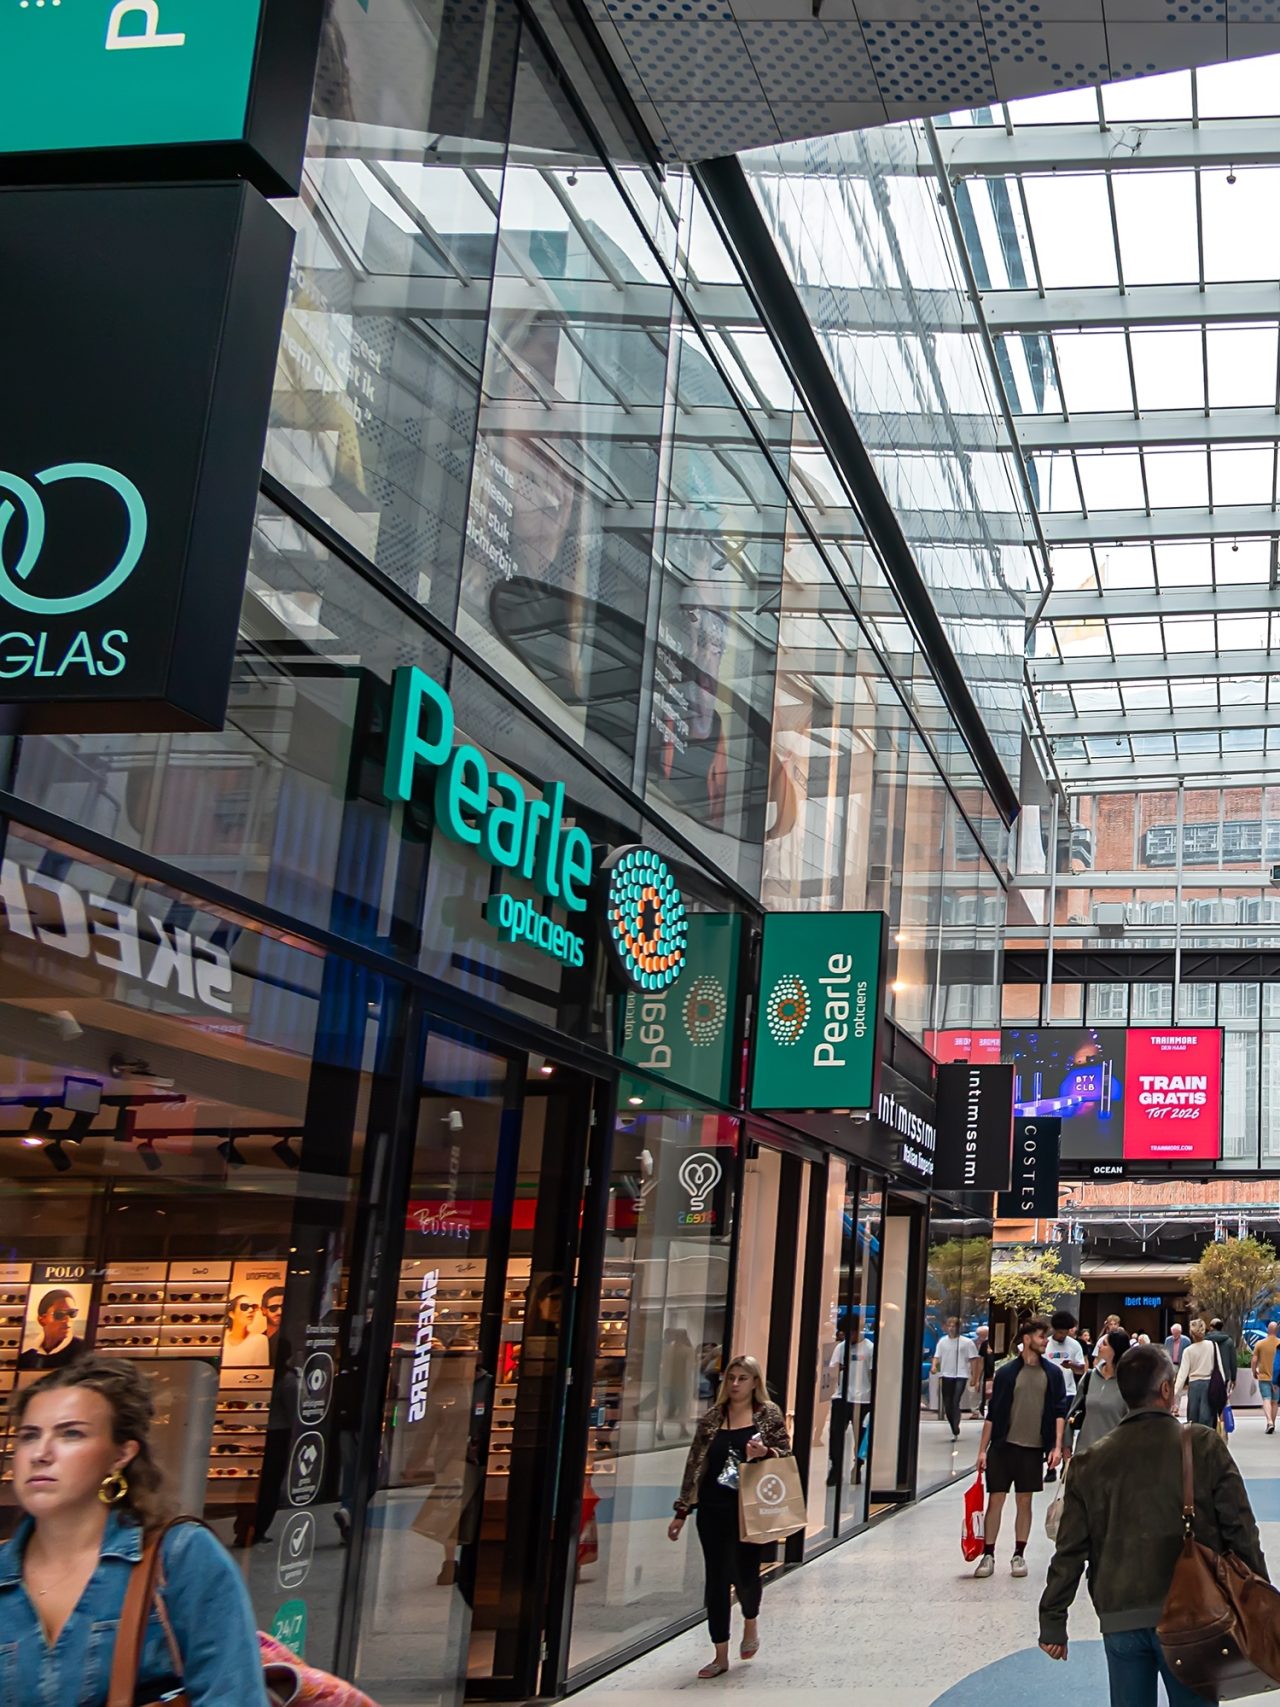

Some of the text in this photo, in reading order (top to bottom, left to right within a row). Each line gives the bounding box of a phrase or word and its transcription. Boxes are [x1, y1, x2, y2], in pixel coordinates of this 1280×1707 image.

[0, 629, 129, 679] GLAS
[388, 665, 592, 912] Pearle
[496, 893, 584, 967] opticiens
[813, 952, 852, 1067] Pearle
[854, 981, 868, 1038] opticiens
[1075, 1075, 1096, 1083] BTY
[1138, 1075, 1207, 1091] TRAIN
[1075, 1083, 1096, 1092] CLB
[1138, 1092, 1207, 1106] GRATIS
[1170, 1107, 1200, 1119] 2026
[1021, 1124, 1039, 1211] COSTES
[1093, 1166, 1123, 1174] OCEAN
[45, 1265, 85, 1278] POLO
